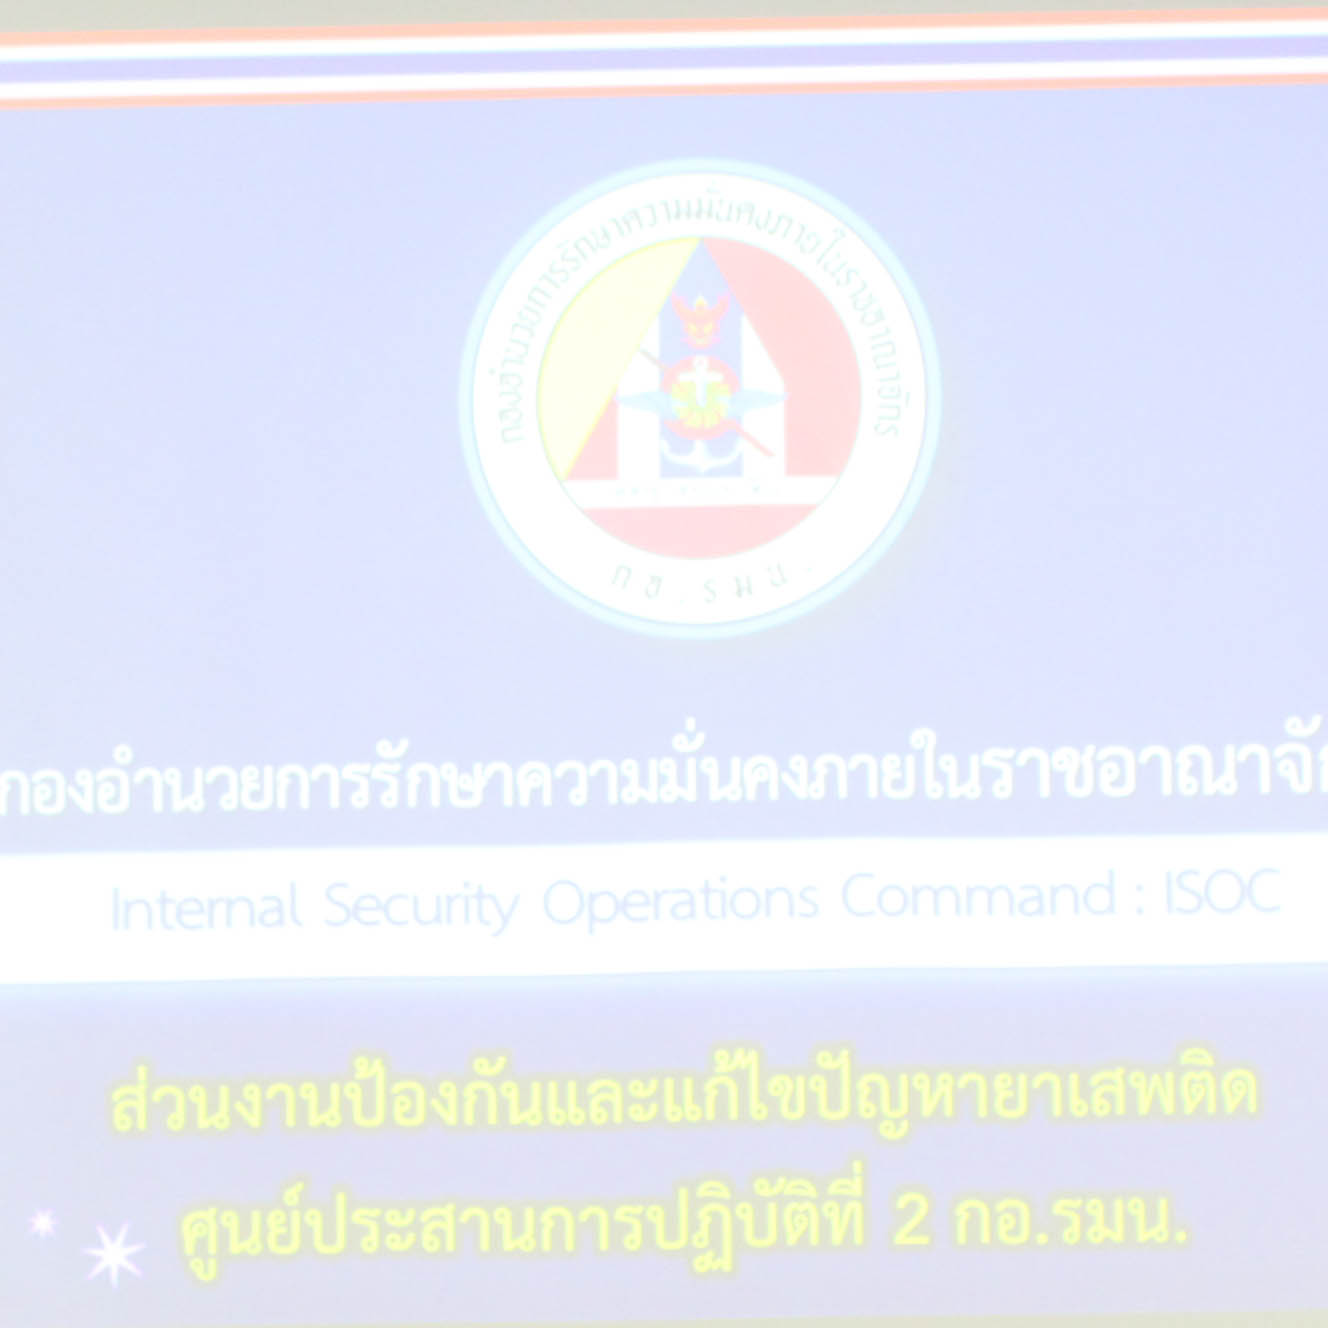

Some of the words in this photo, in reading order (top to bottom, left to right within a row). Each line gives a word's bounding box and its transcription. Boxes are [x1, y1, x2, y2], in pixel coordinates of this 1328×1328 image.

[113, 882, 302, 930] Internal
[326, 882, 519, 936] Security
[544, 876, 818, 935] Operations
[843, 869, 1115, 917] Command
[1167, 868, 1280, 914] ISOC
[113, 1050, 1257, 1139] ส่วนงานป้องกันและแก้ไขปัญหายาเสพติด
[183, 1162, 863, 1280] ศูนย์ประสานการปฏิบัติที่
[895, 1194, 929, 1244] 2
[958, 1199, 1186, 1243] กอ.รมน.
